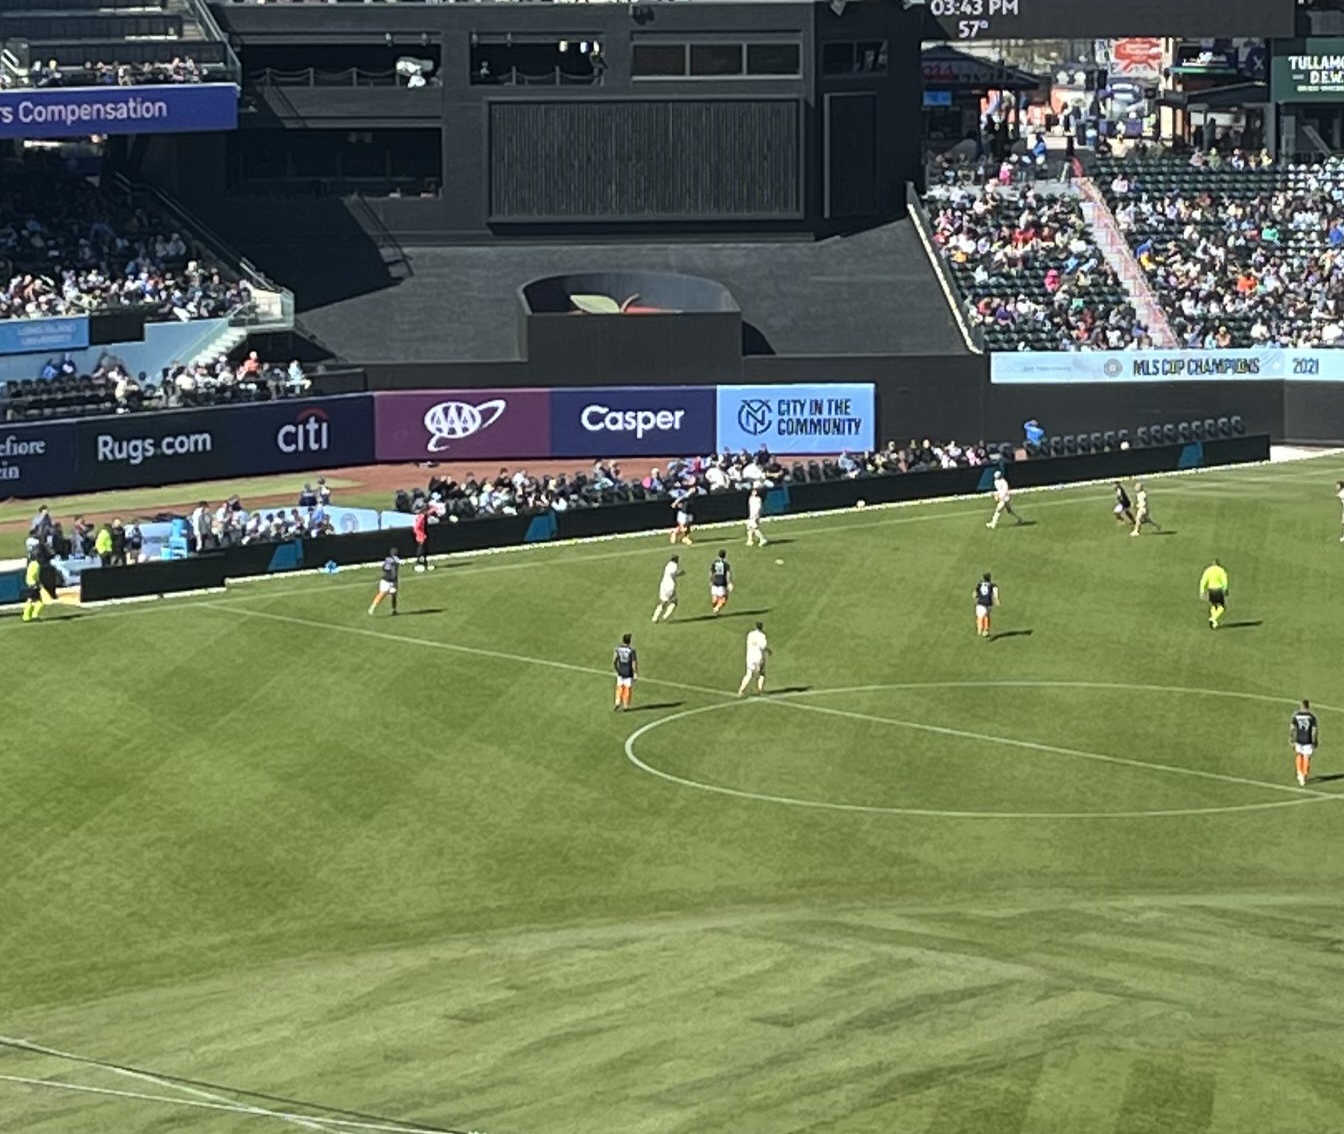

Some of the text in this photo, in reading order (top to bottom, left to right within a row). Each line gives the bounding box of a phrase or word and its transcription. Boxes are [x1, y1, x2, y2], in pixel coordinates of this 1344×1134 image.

[18, 97, 169, 128] Compensation
[1133, 357, 1319, 376] MLS CUP CHAMPIONS 2021
[777, 398, 852, 417] CITY IN THE
[581, 404, 685, 439] Casper
[777, 417, 863, 436] COMMUNITY
[278, 421, 328, 453] citi
